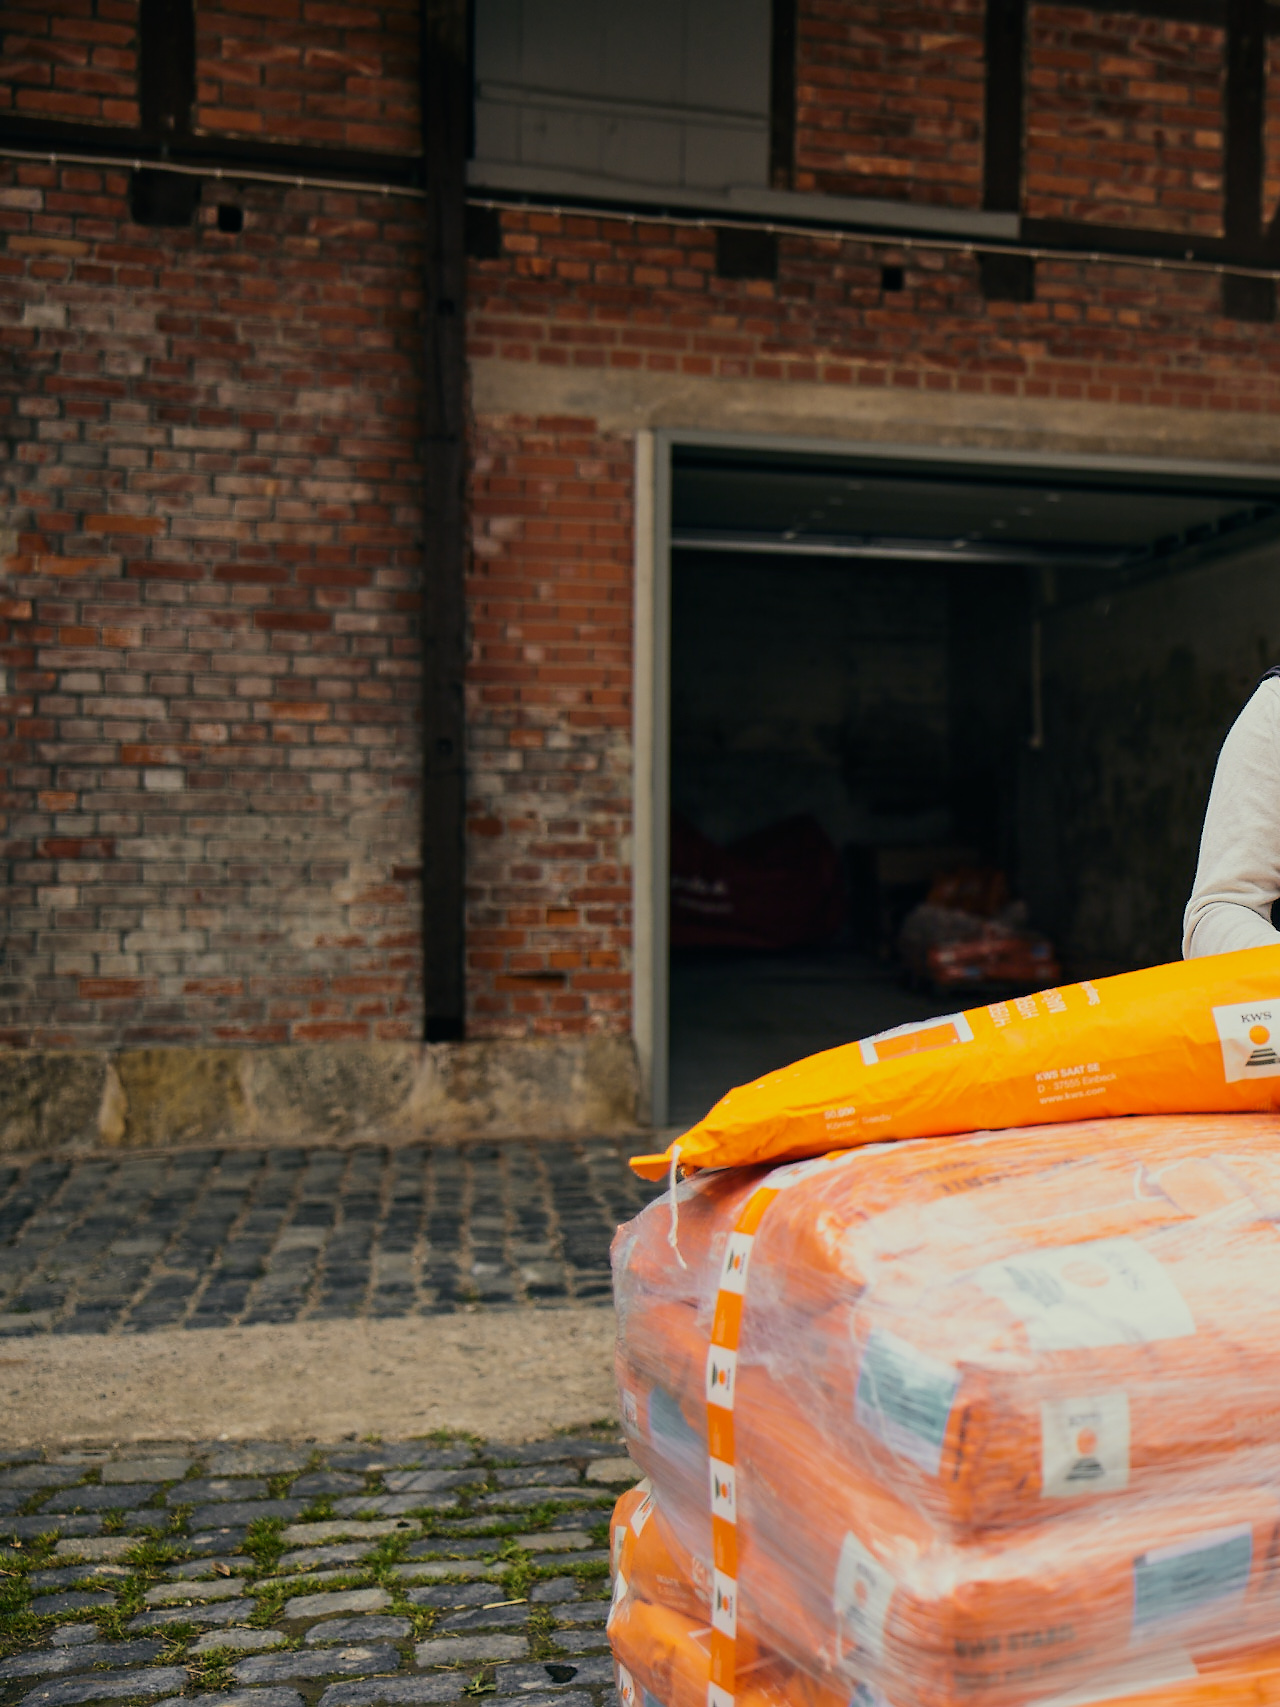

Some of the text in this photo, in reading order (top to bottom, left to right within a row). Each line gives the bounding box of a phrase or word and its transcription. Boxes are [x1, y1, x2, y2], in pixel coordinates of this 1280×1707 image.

[1240, 1011, 1272, 1023] KWS
[1035, 1062, 1100, 1082] KWS SAAT SE
[1037, 1083, 1045, 1094] D
[1082, 1072, 1117, 1086] Einbeck
[1039, 1087, 1106, 1105] www.kws.com
